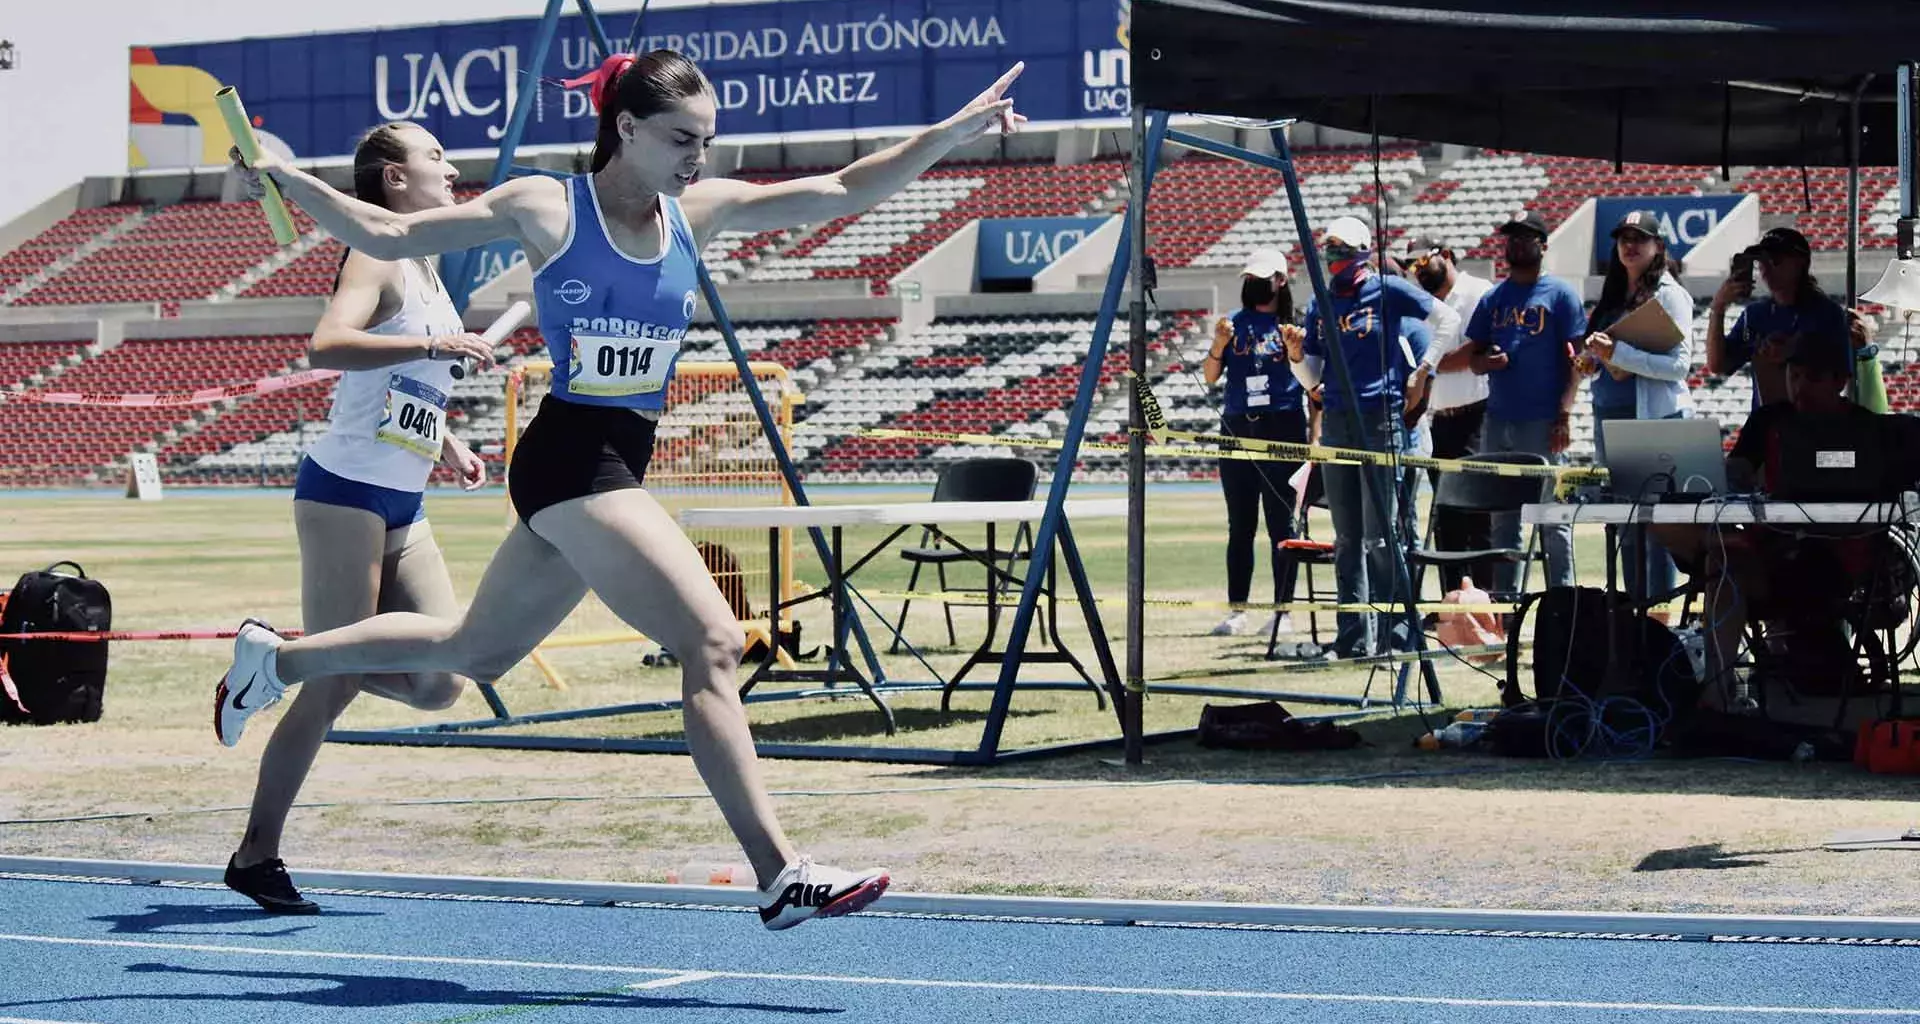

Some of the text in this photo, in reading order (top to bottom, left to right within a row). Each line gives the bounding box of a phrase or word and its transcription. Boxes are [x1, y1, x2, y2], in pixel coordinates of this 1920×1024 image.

[796, 13, 1006, 55] AUTÓNOMA
[375, 45, 518, 139] UACJ
[757, 69, 878, 115] JUÁREZ
[1492, 305, 1545, 335] UACJ
[597, 345, 654, 377] 0114
[399, 402, 437, 441] 0401
[780, 882, 833, 908] AIR
